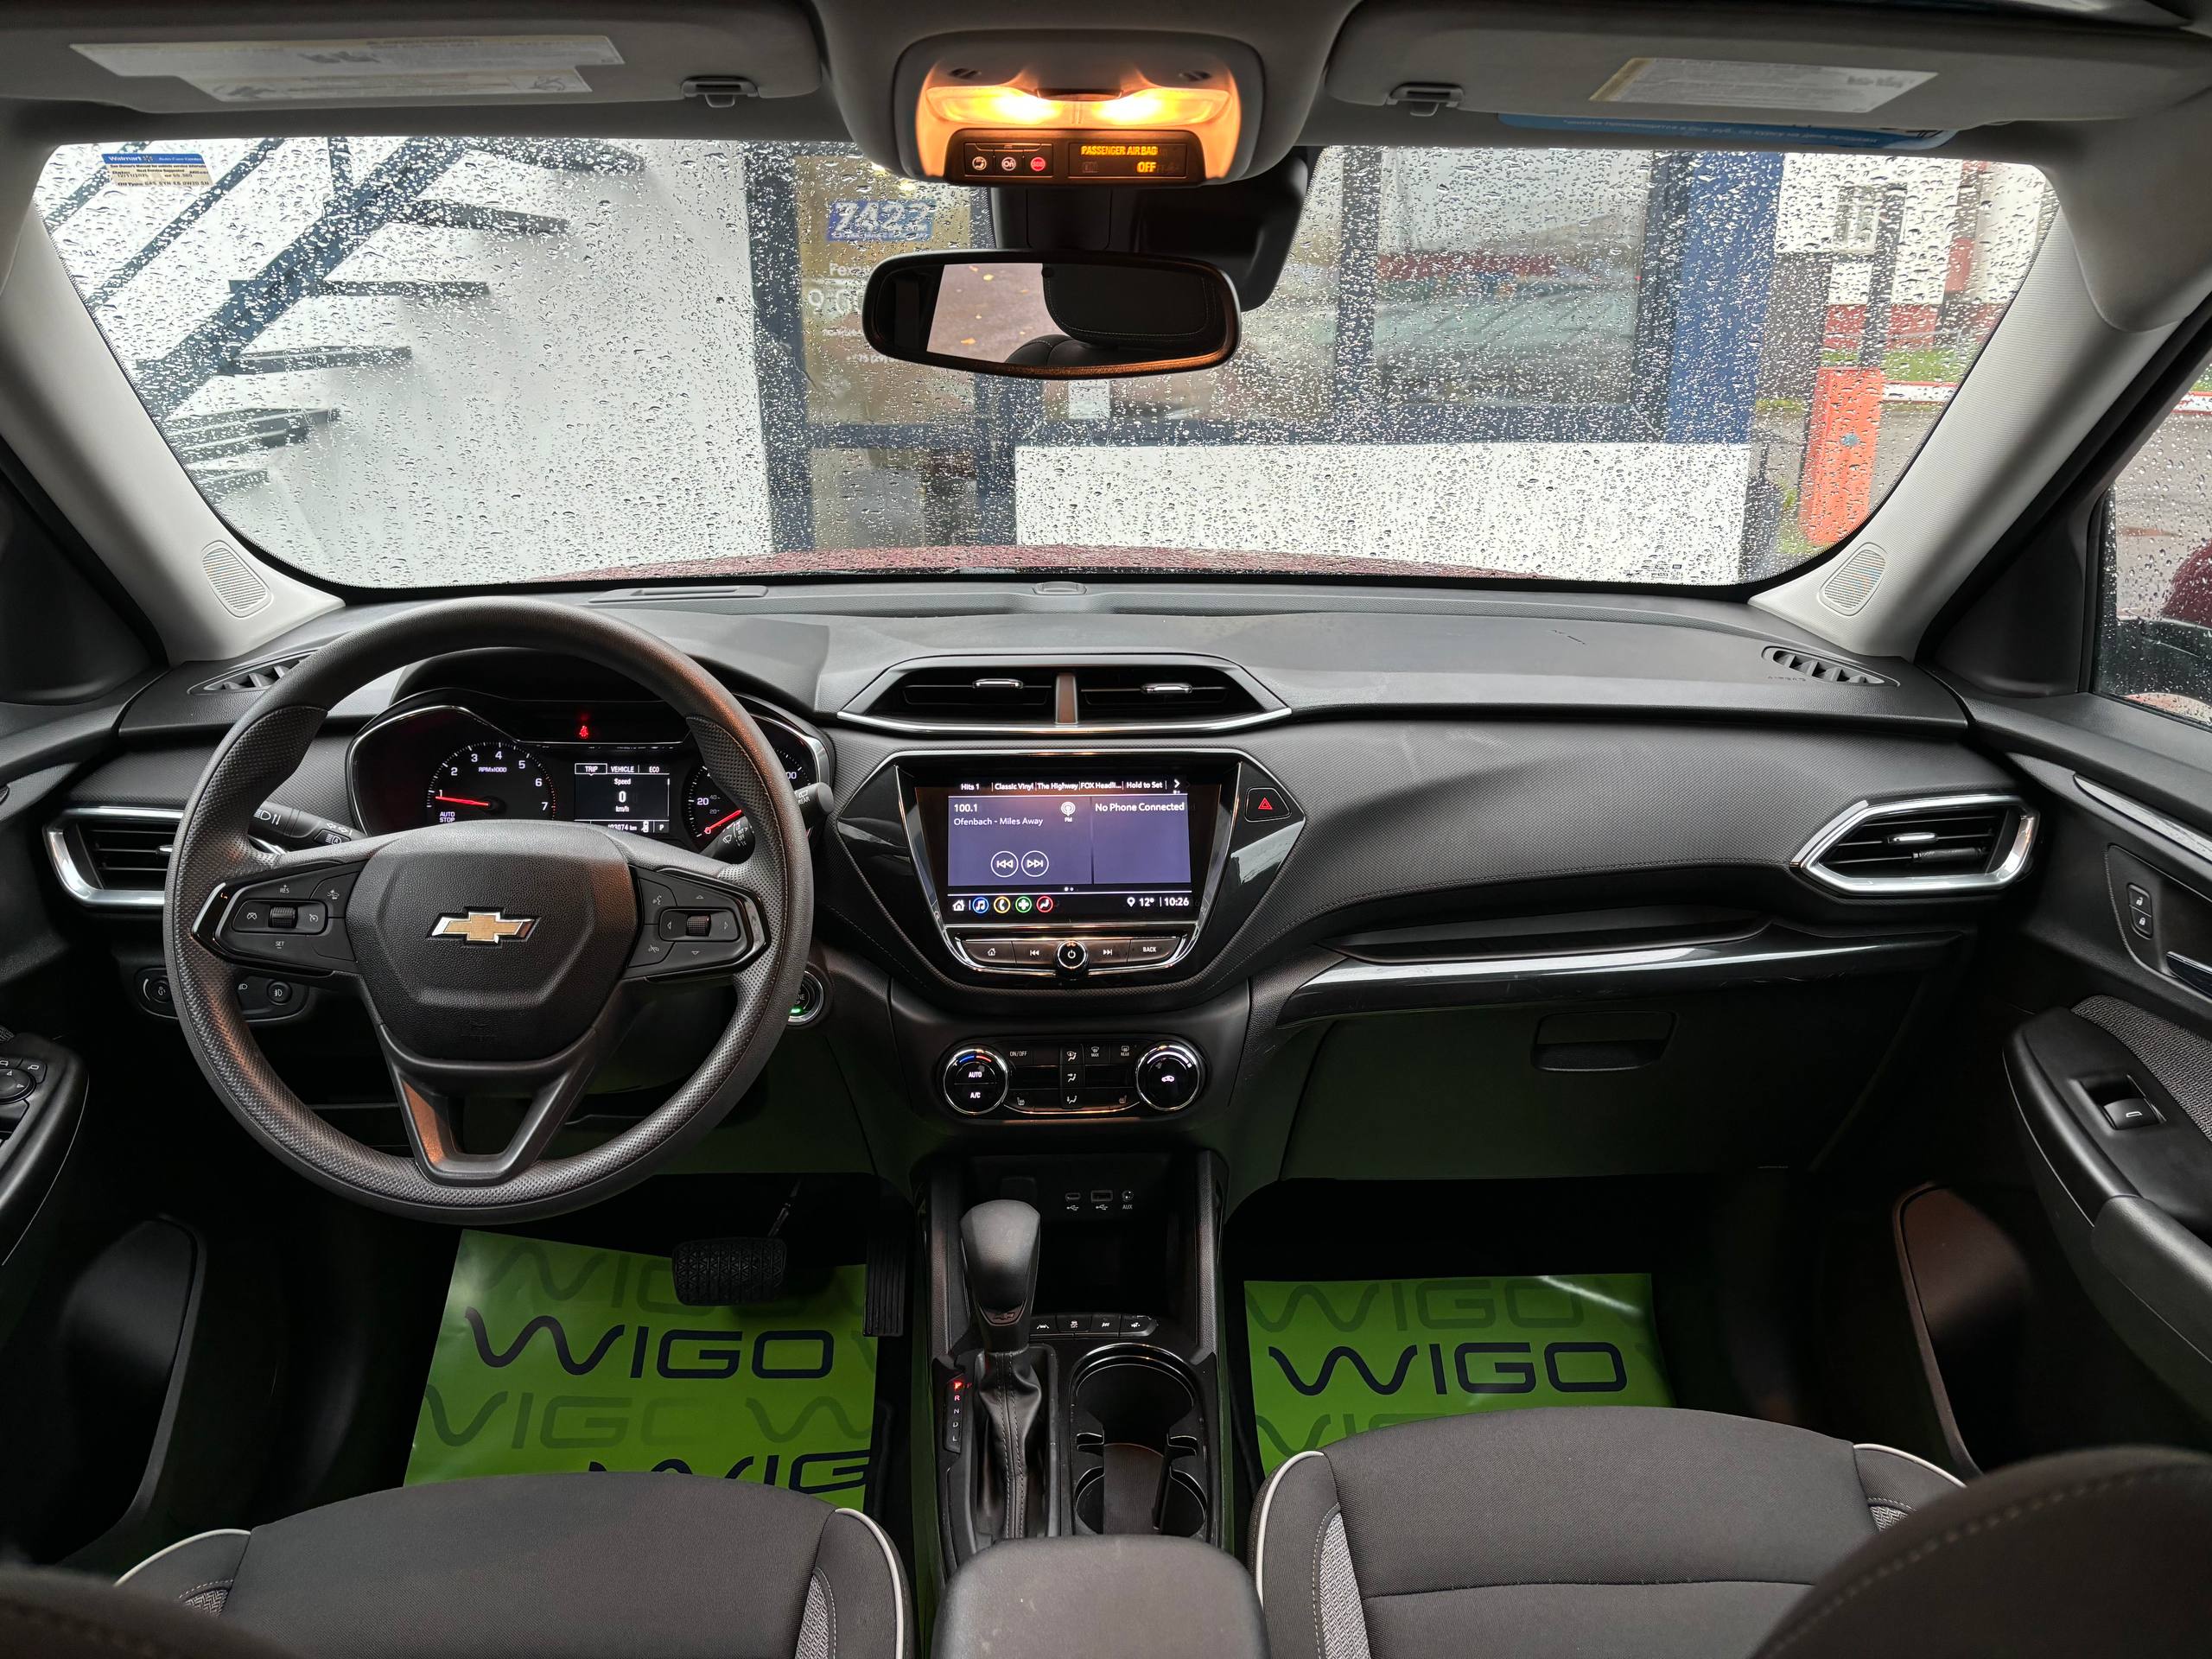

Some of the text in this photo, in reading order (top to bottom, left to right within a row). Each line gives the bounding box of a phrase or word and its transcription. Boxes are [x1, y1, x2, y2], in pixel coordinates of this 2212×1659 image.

[1081, 146, 1125, 156] PASSENGER
[1137, 162, 1157, 172] OFF
[471, 753, 478, 762] 3
[495, 751, 502, 760] 4
[518, 760, 526, 769] 5
[450, 767, 458, 776] 2
[535, 778, 543, 787] 6
[1018, 783, 1033, 791] Vinyl
[1050, 782, 1078, 791] Highway
[619, 791, 626, 803] 0
[541, 802, 549, 810] 7
[954, 804, 978, 812] 100.1
[1095, 802, 1185, 811] No Phone Connected
[1022, 817, 1044, 827] Away
[1164, 897, 1190, 906] 10:26
[465, 1306, 834, 1379] WIGO
[1268, 1342, 1628, 1396] WIGO
